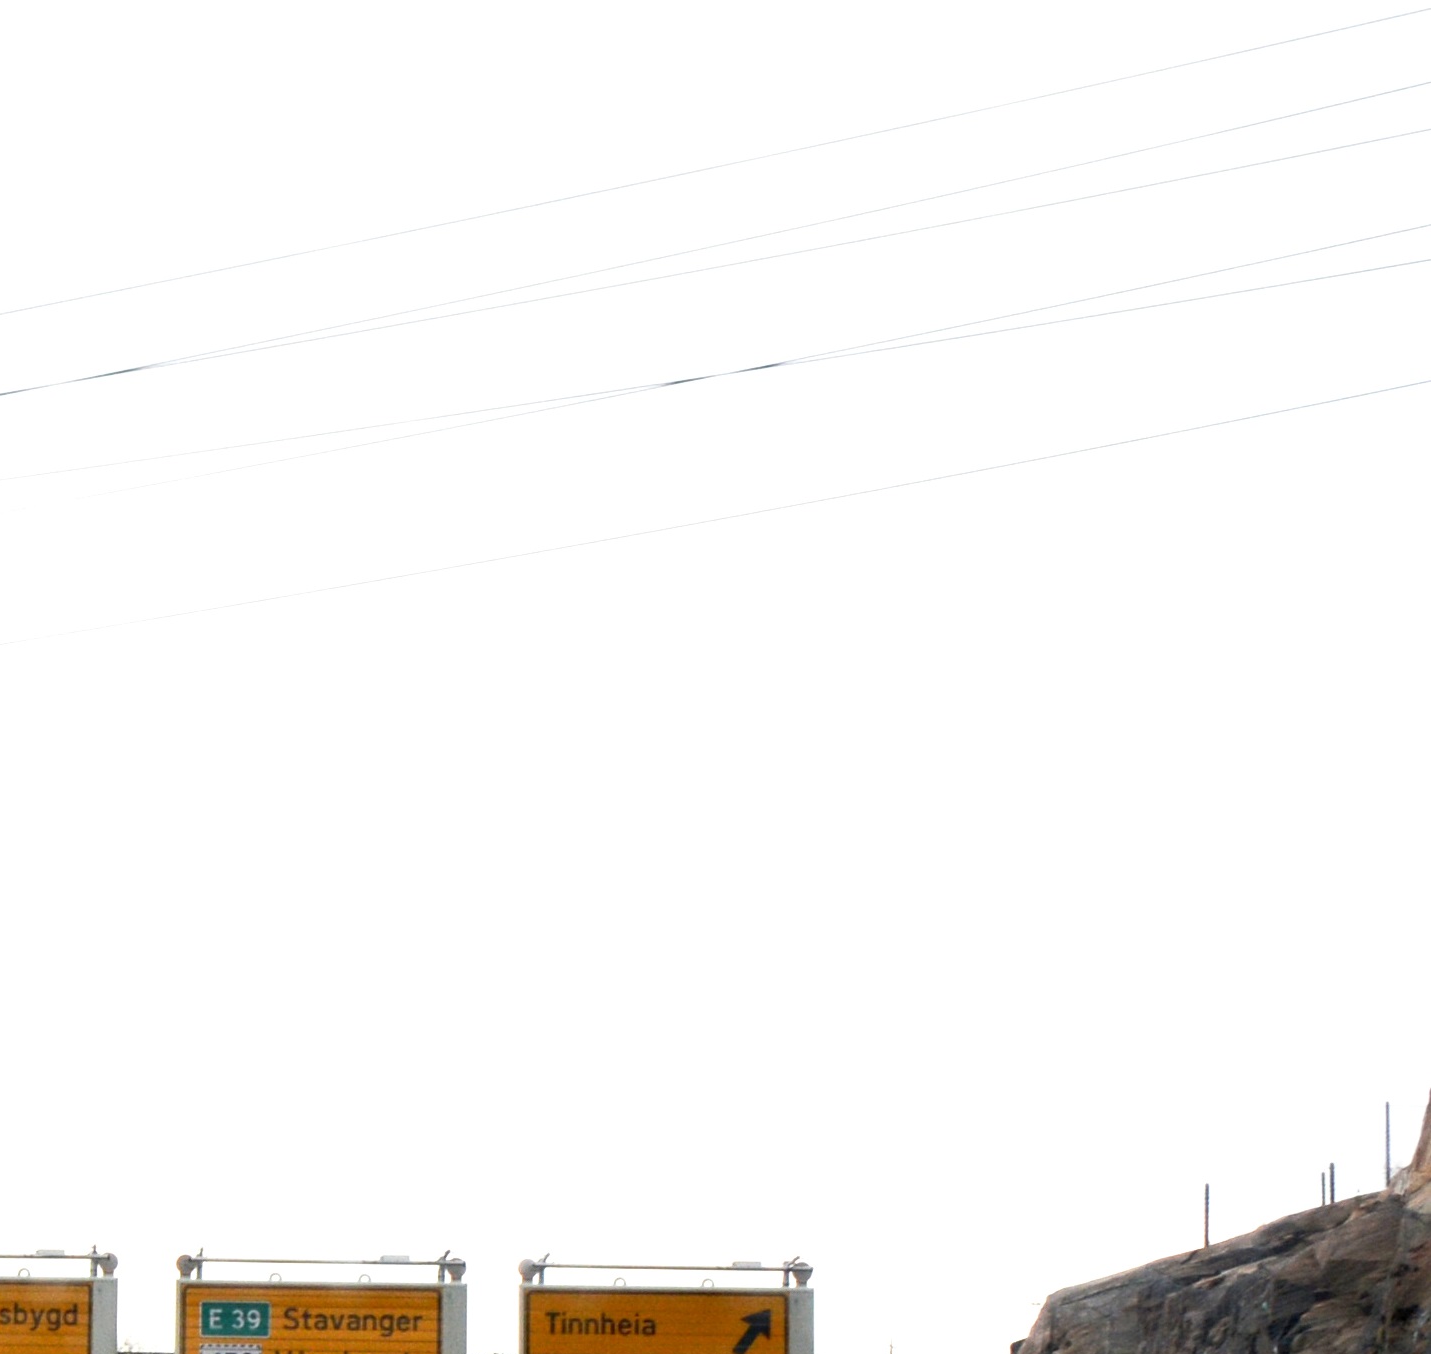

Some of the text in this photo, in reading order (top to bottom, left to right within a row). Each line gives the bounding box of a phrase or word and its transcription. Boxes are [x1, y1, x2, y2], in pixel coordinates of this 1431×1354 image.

[208, 1307, 423, 1337] E 39 Stavanger
[546, 1312, 657, 1337] Tinnheia
